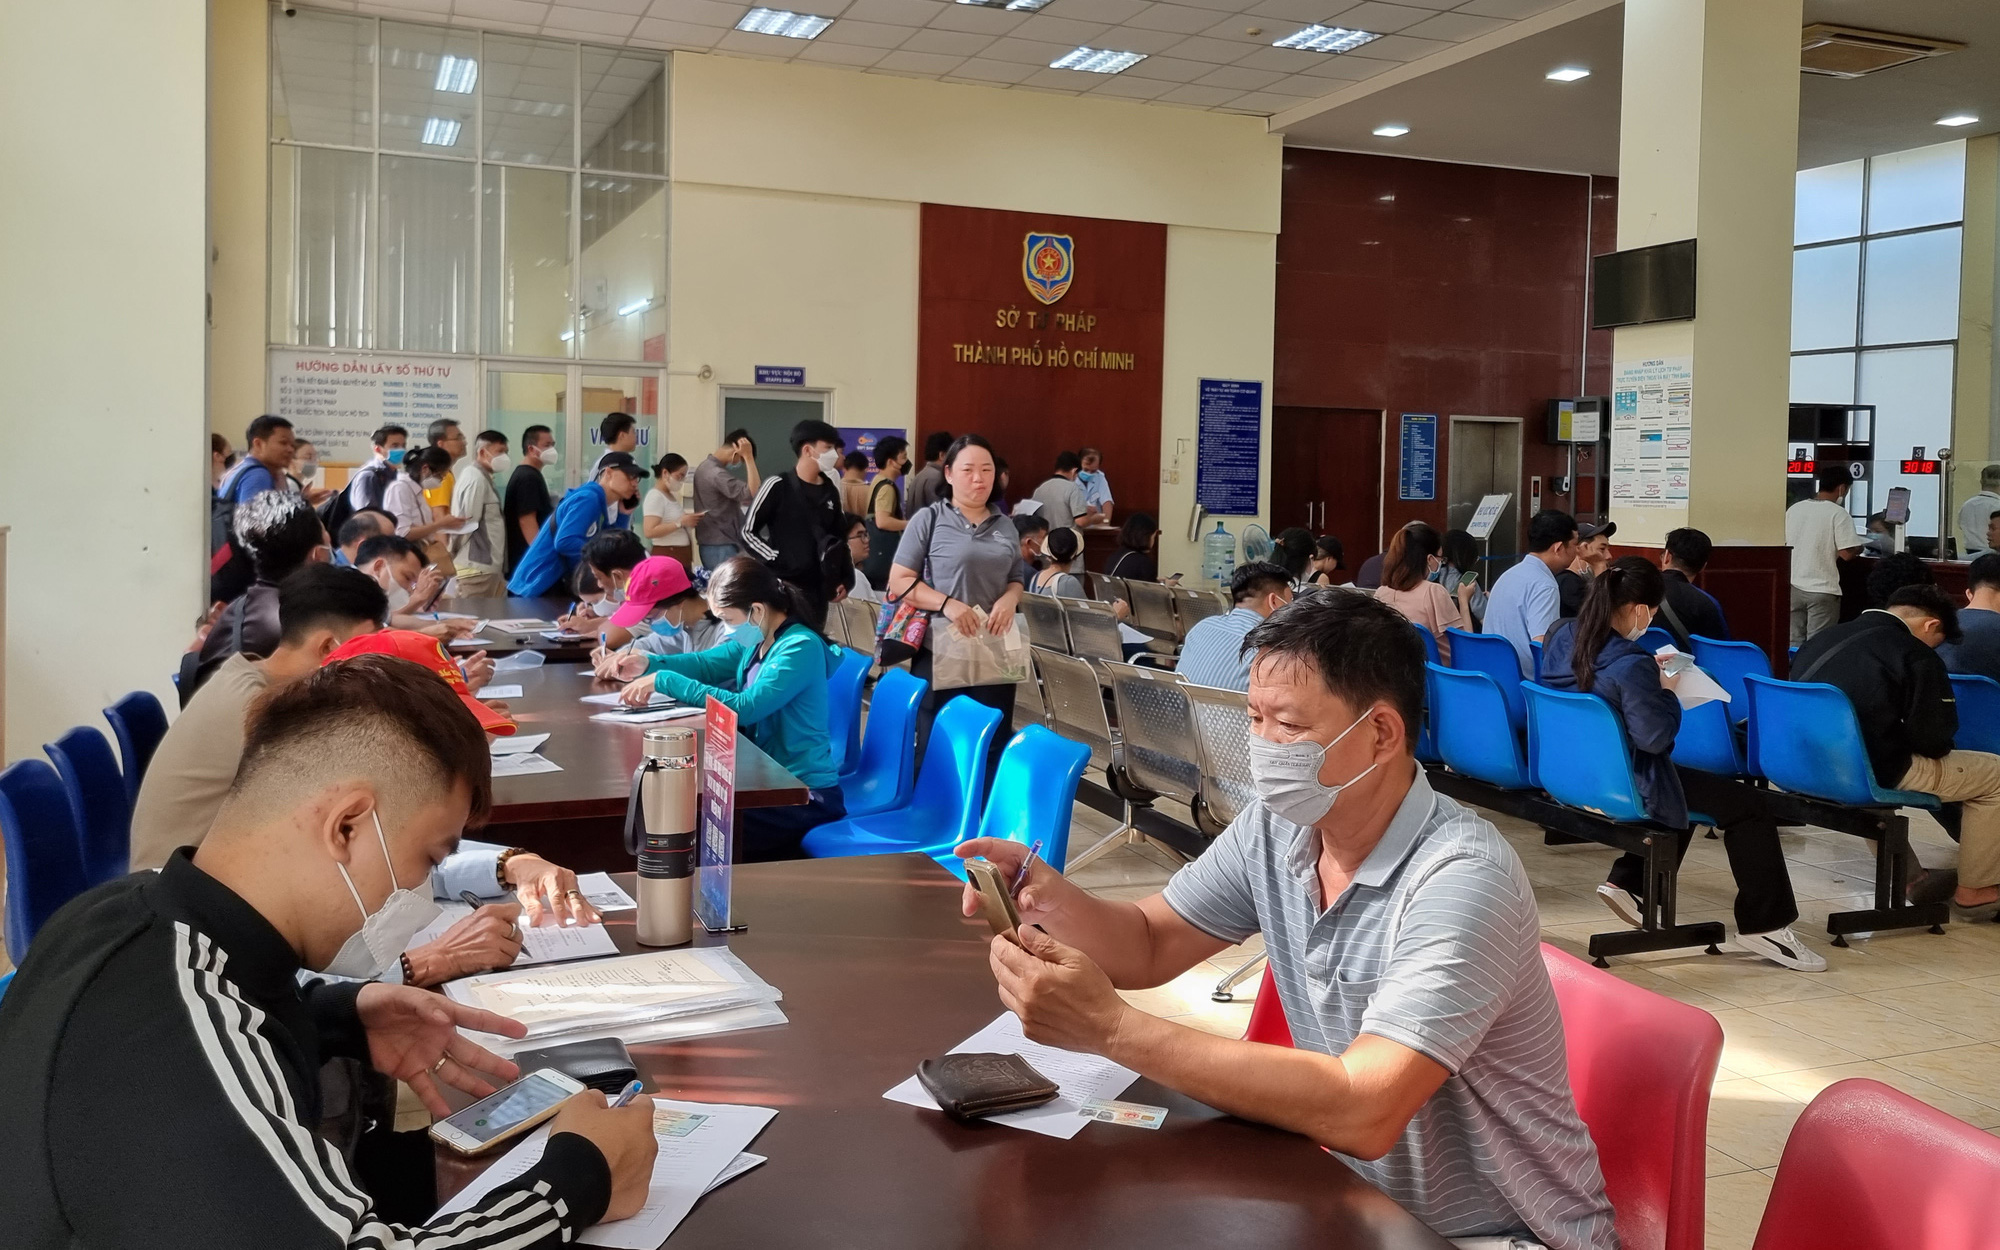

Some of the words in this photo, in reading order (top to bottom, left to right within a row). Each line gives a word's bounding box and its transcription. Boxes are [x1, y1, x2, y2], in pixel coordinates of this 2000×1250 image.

[996, 304, 1020, 328] SỞ
[1056, 311, 1097, 333] PHÁP
[953, 340, 1006, 364] THÀNH
[1012, 339, 1043, 367] PHỐ
[1048, 341, 1069, 367] HỒ
[1074, 347, 1097, 369] CHÍ
[1100, 351, 1135, 370] MINH
[296, 360, 339, 372] HƯỚNG
[371, 362, 392, 374] LẤY
[396, 362, 410, 375] SỐ
[413, 364, 435, 376] THỨ
[1915, 449, 1922, 458] 3
[1788, 461, 1814, 473] 2019
[1853, 463, 1861, 477] 3
[1903, 461, 1934, 473] 3018
